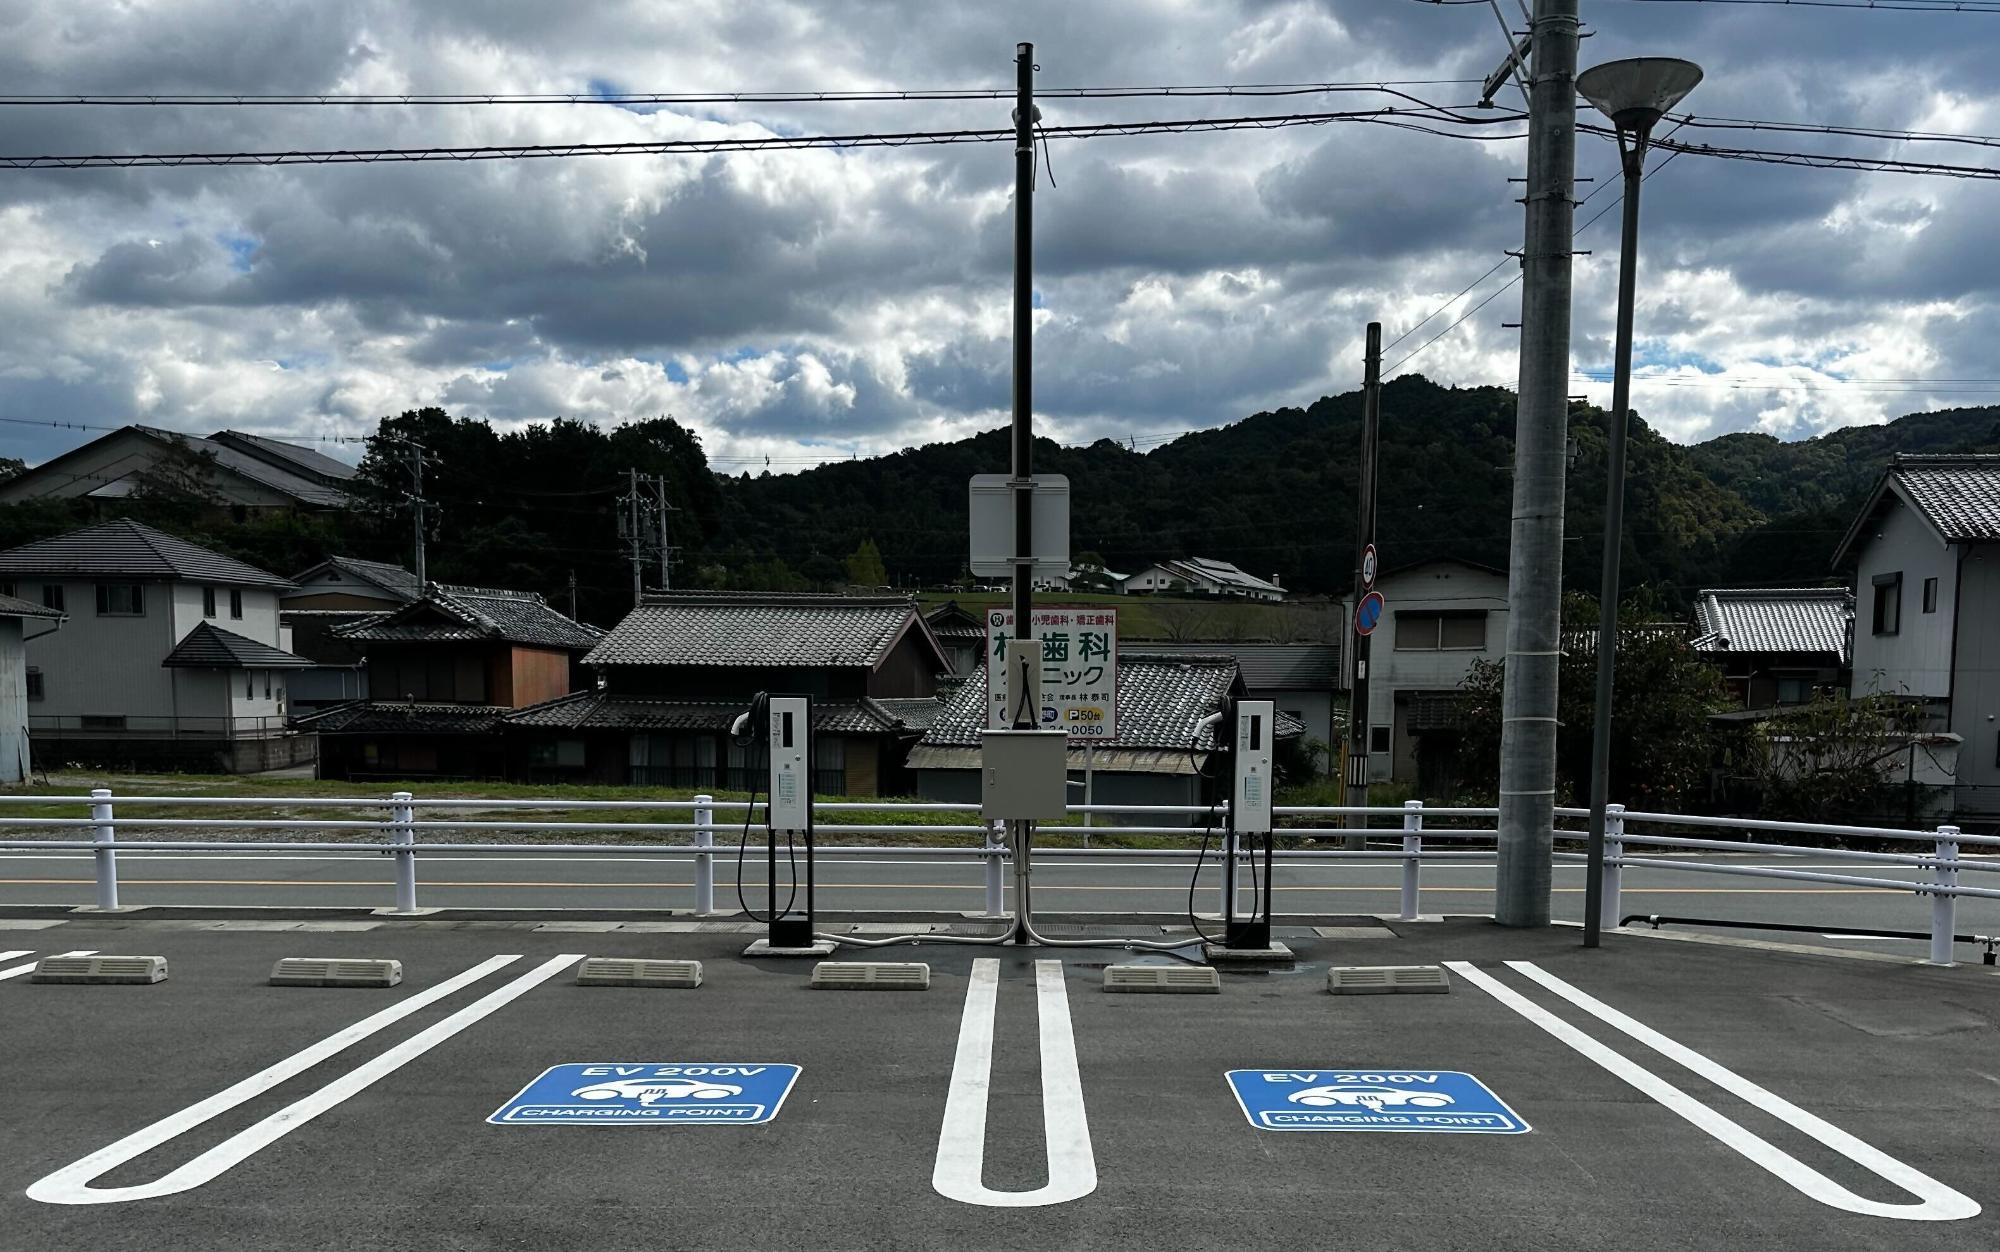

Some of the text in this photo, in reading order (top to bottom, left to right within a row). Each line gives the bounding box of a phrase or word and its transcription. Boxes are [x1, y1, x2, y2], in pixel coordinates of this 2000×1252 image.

[1365, 557, 1373, 576] 40
[581, 1066, 768, 1077] EV 200V
[1262, 1073, 1439, 1084] EV 200V
[521, 1108, 752, 1118] CHARGING POINT
[1274, 1114, 1497, 1126] CHARGING POINT
